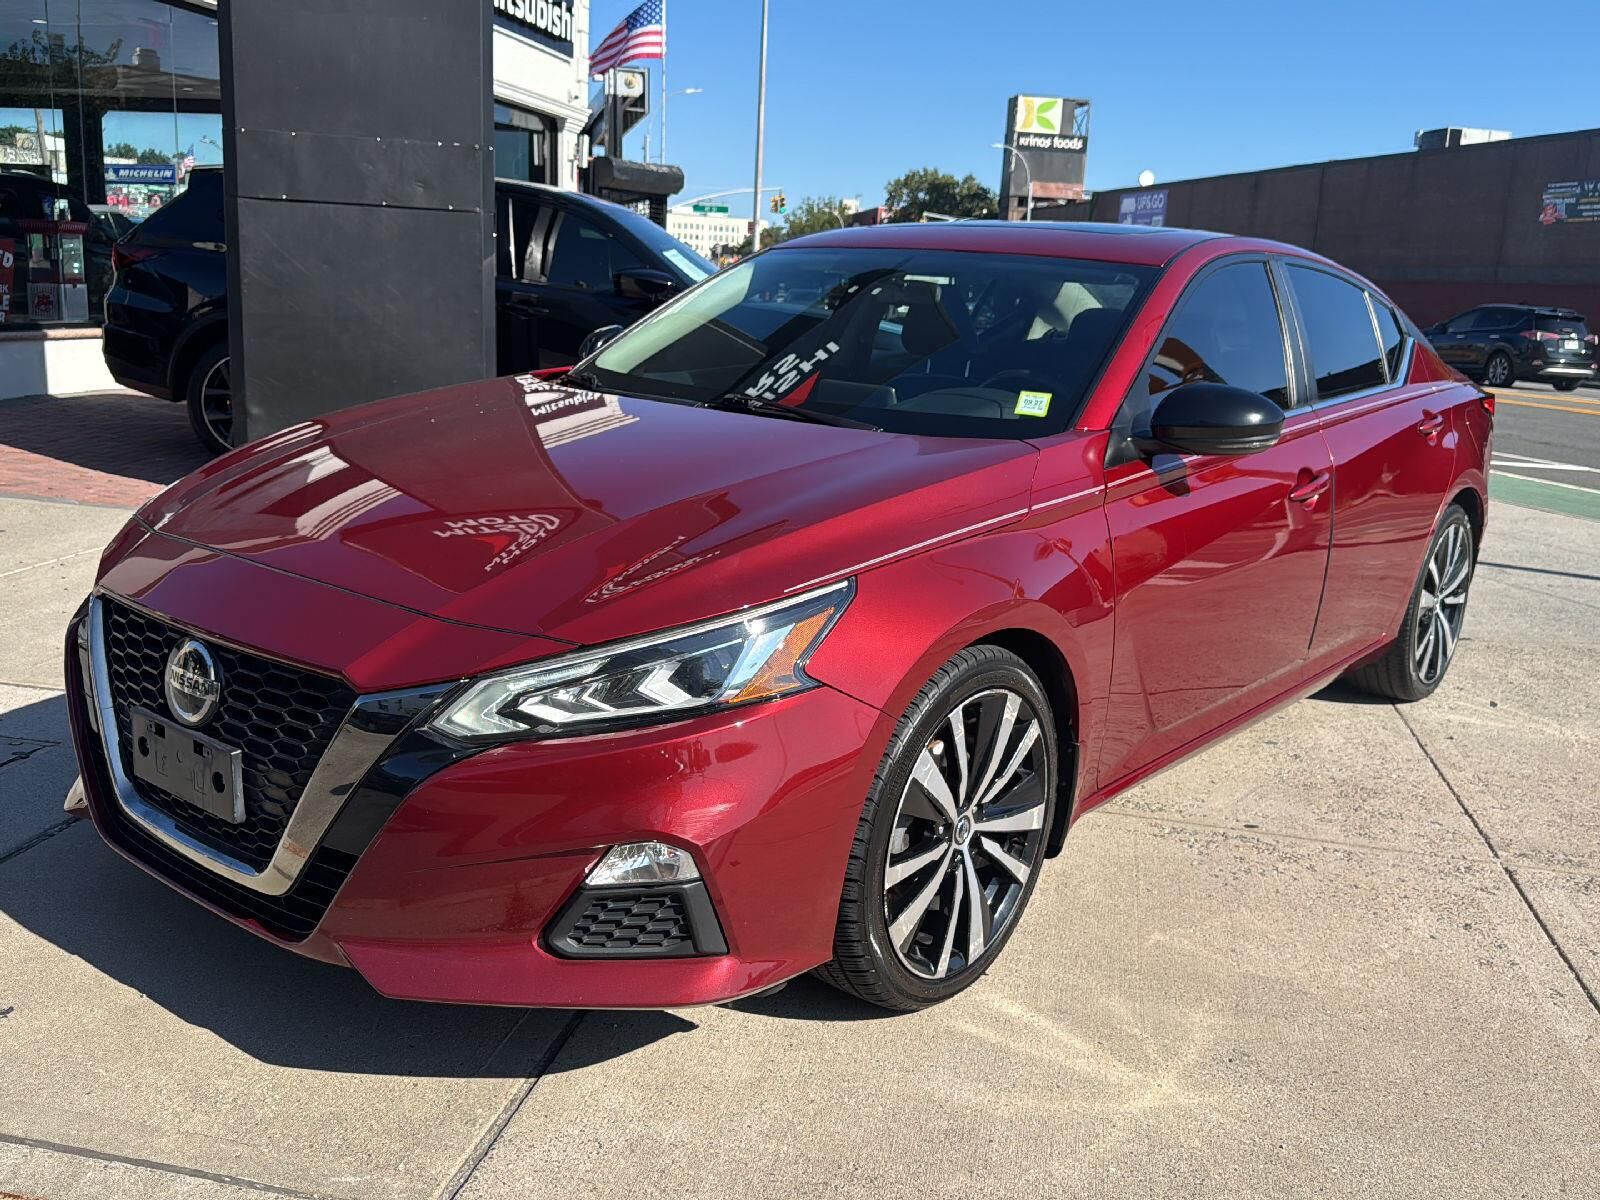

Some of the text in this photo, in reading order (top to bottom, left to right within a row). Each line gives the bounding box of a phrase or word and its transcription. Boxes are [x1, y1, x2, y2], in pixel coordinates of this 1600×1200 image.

[1053, 136, 1083, 150] foods
[119, 168, 173, 178] MICHELIN
[170, 668, 212, 696] NISSAN
